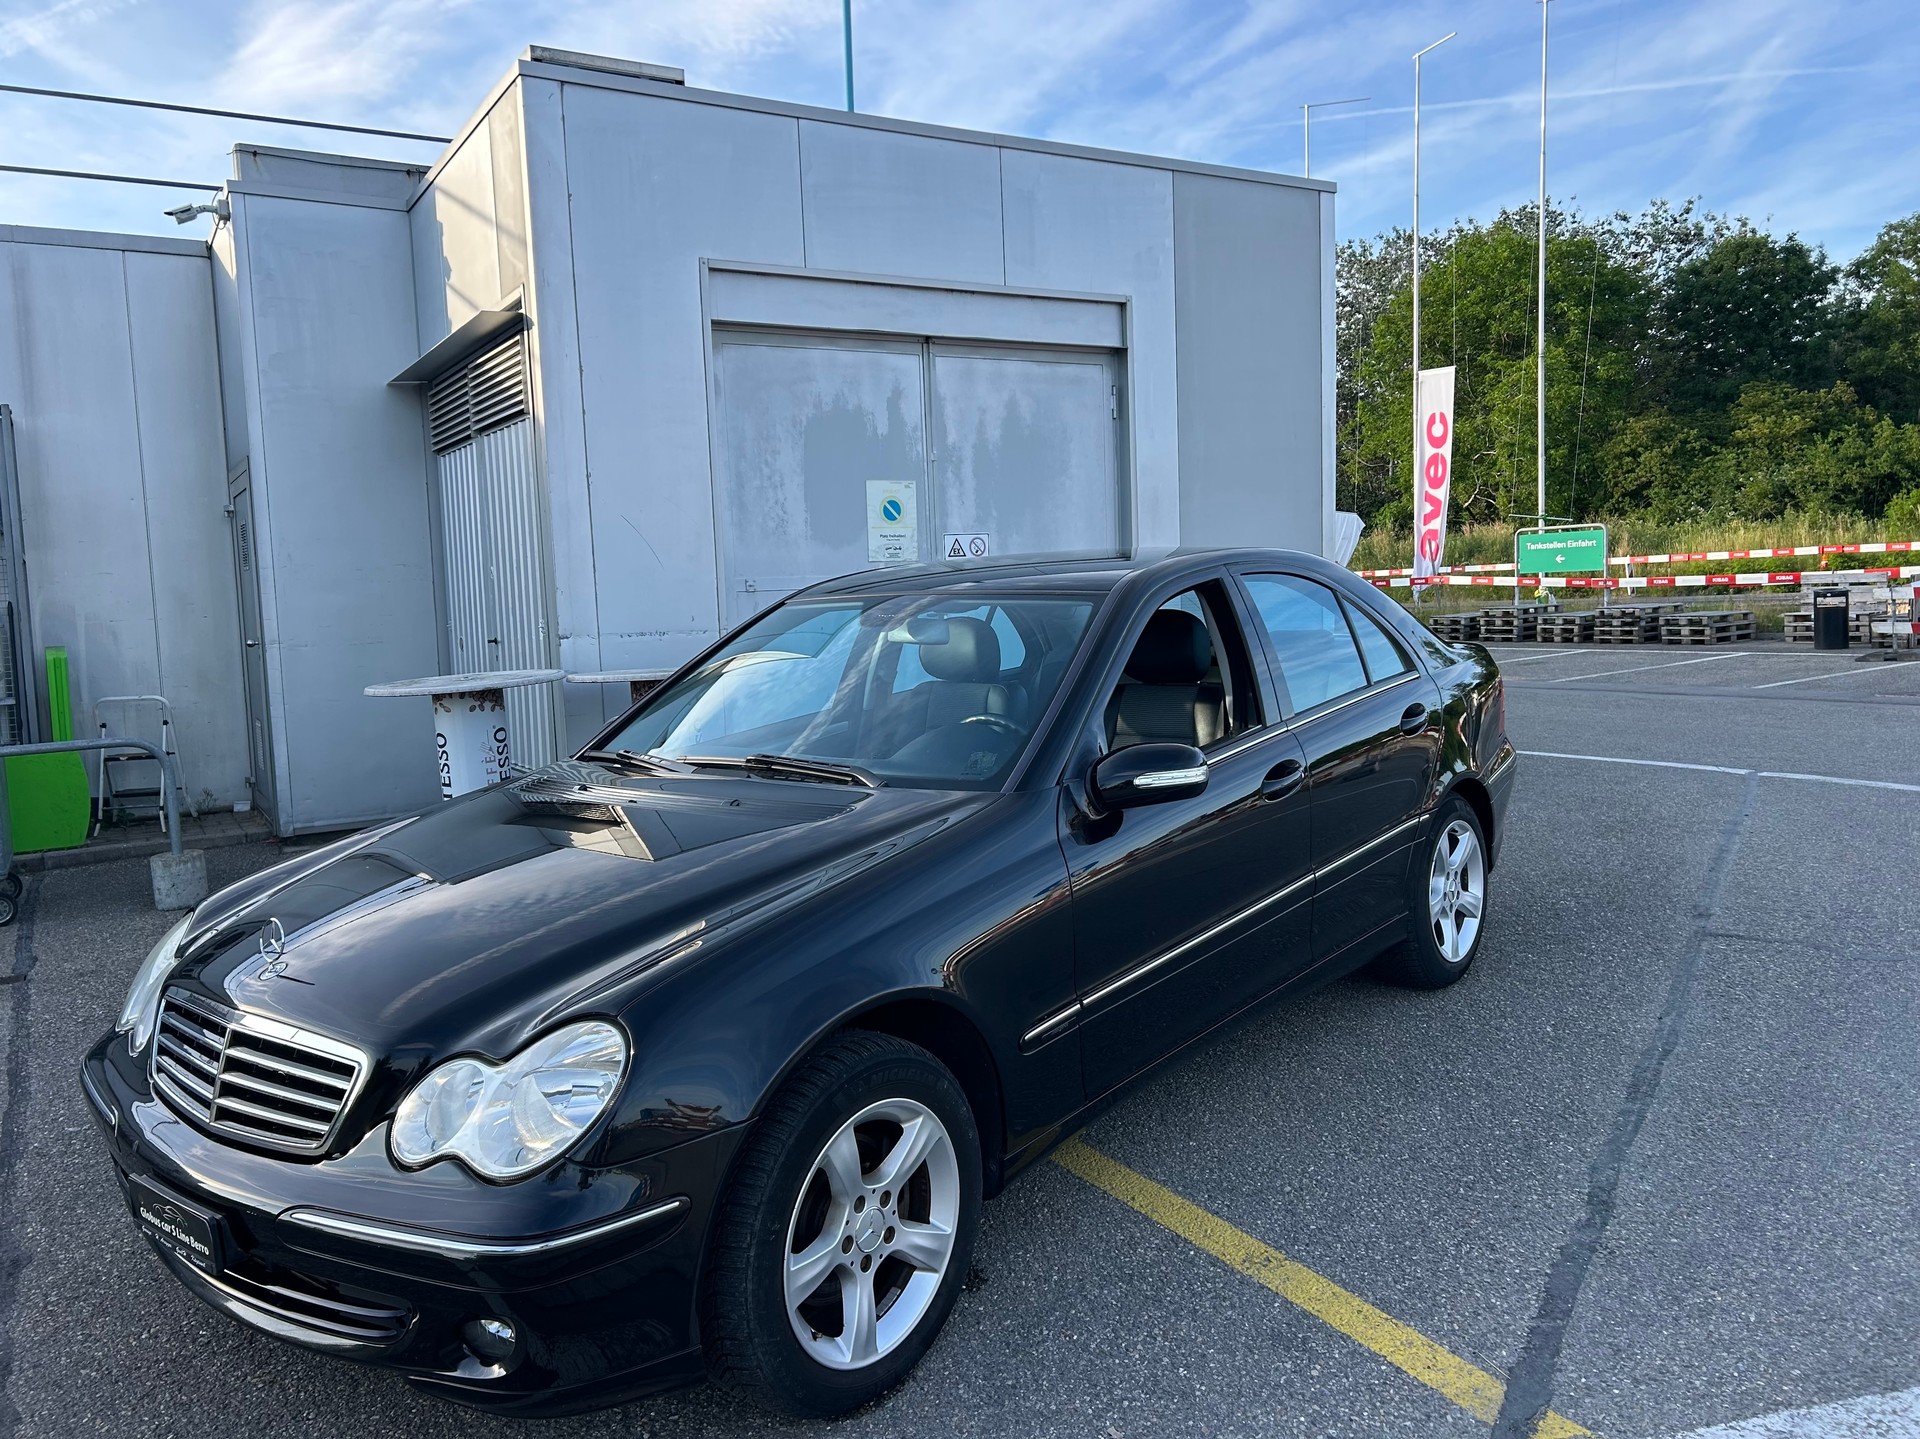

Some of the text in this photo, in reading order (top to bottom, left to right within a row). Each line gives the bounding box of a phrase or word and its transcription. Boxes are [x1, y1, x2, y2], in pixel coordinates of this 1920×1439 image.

[1420, 411, 1448, 561] avec
[1526, 539, 1597, 550] Tankstellen Einfahrt
[140, 1206, 161, 1228] Globus
[176, 1227, 190, 1245] Line
